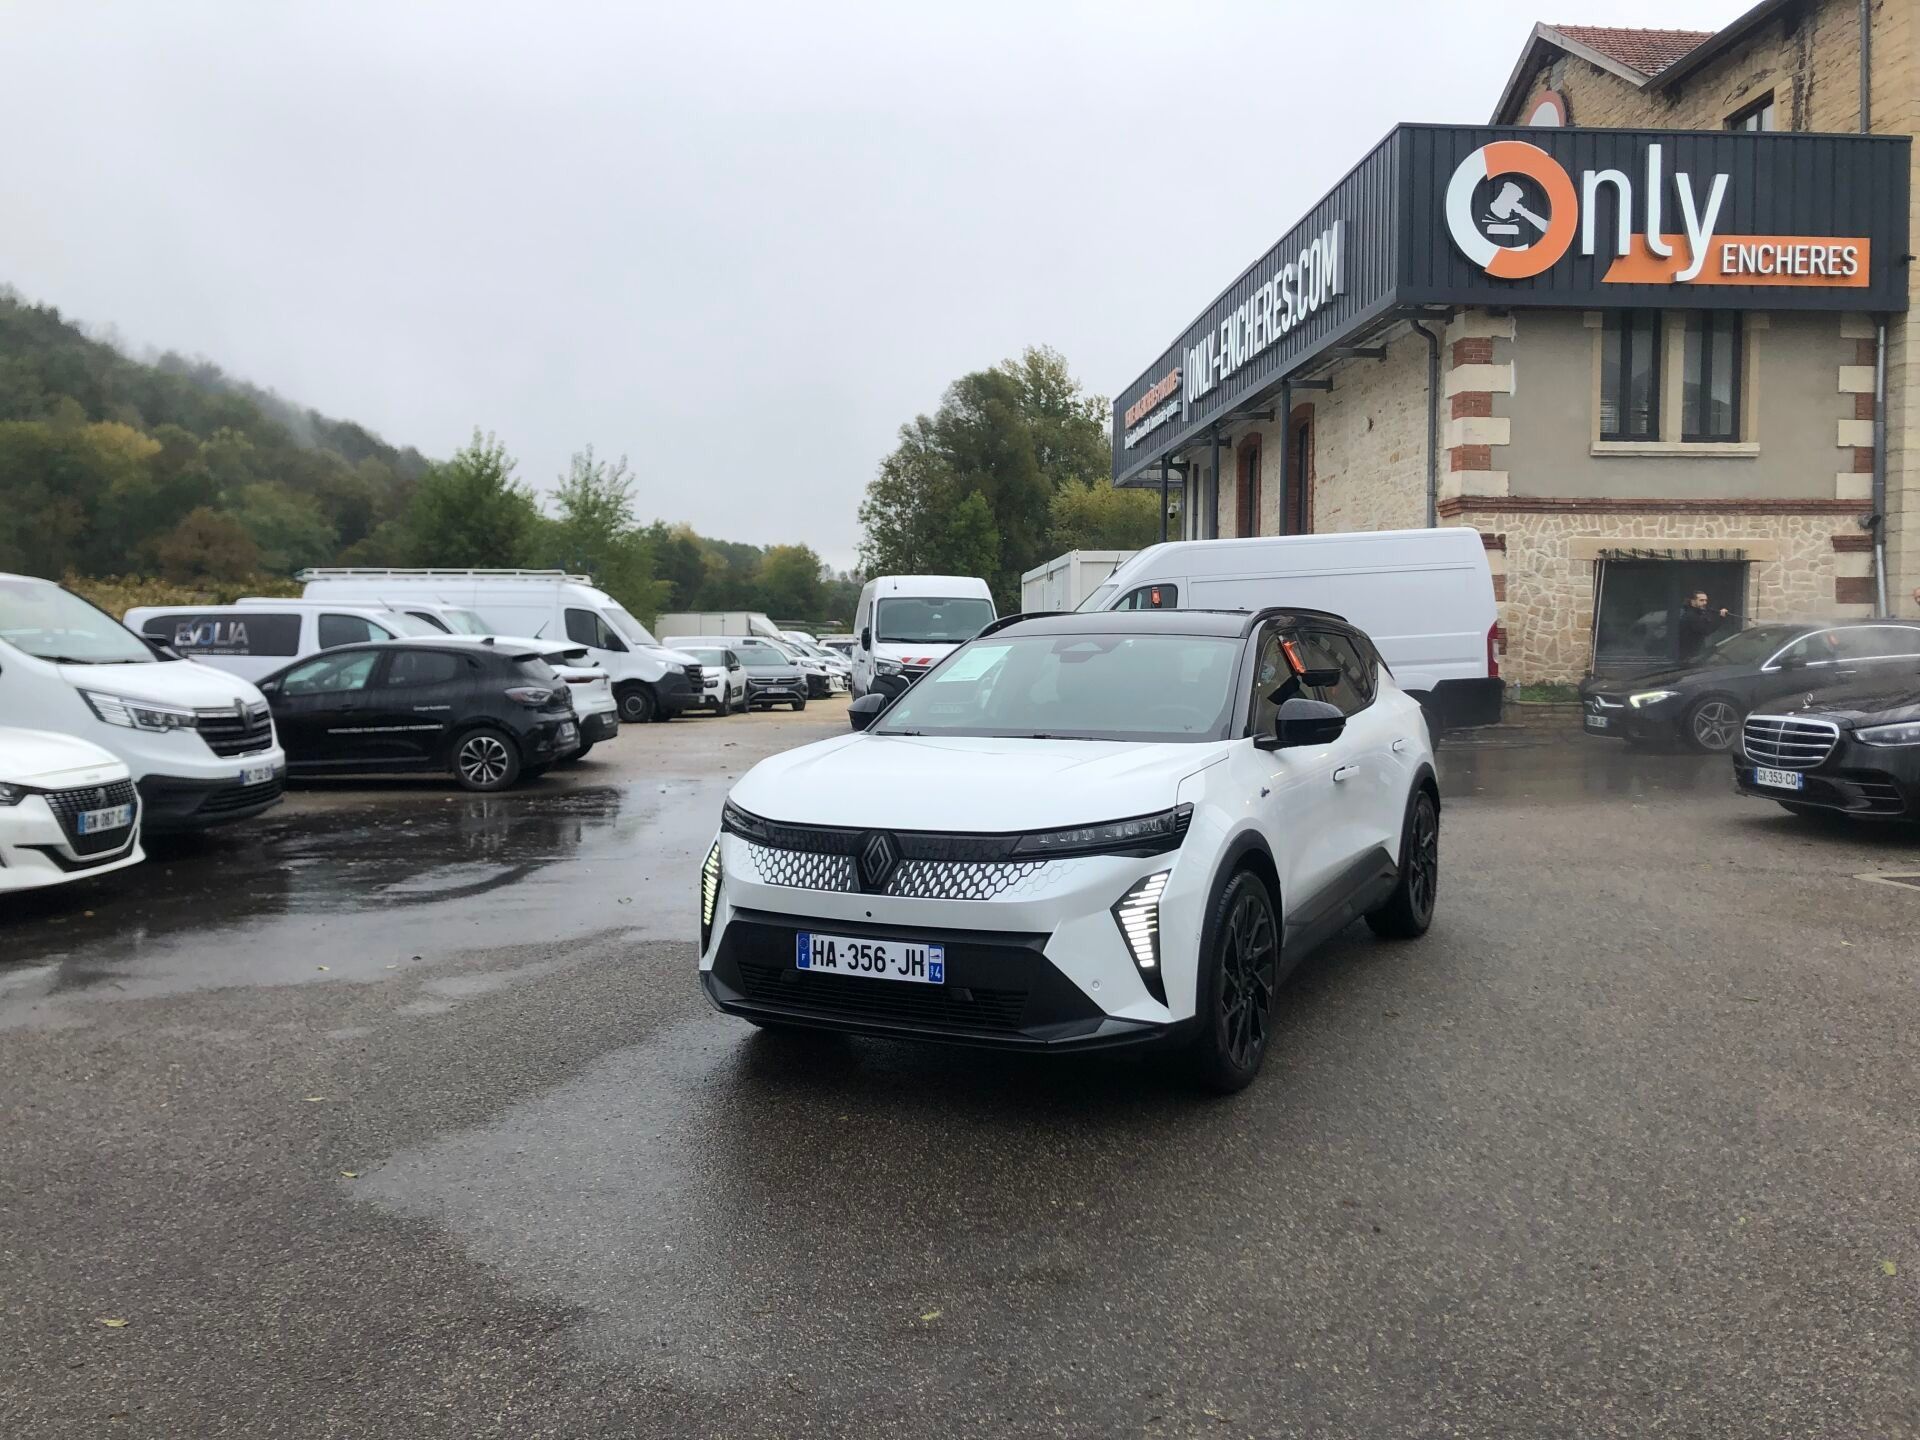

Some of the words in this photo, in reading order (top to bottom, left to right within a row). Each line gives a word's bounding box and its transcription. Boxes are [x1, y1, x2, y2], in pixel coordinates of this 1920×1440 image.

[1446, 140, 1729, 283] Only
[1722, 243, 1858, 276] ENCHERES
[1188, 220, 1343, 404] ONLY-ENCHERES.COM
[175, 622, 249, 646] EVOLIA
[812, 939, 925, 977] HA-356-JH
